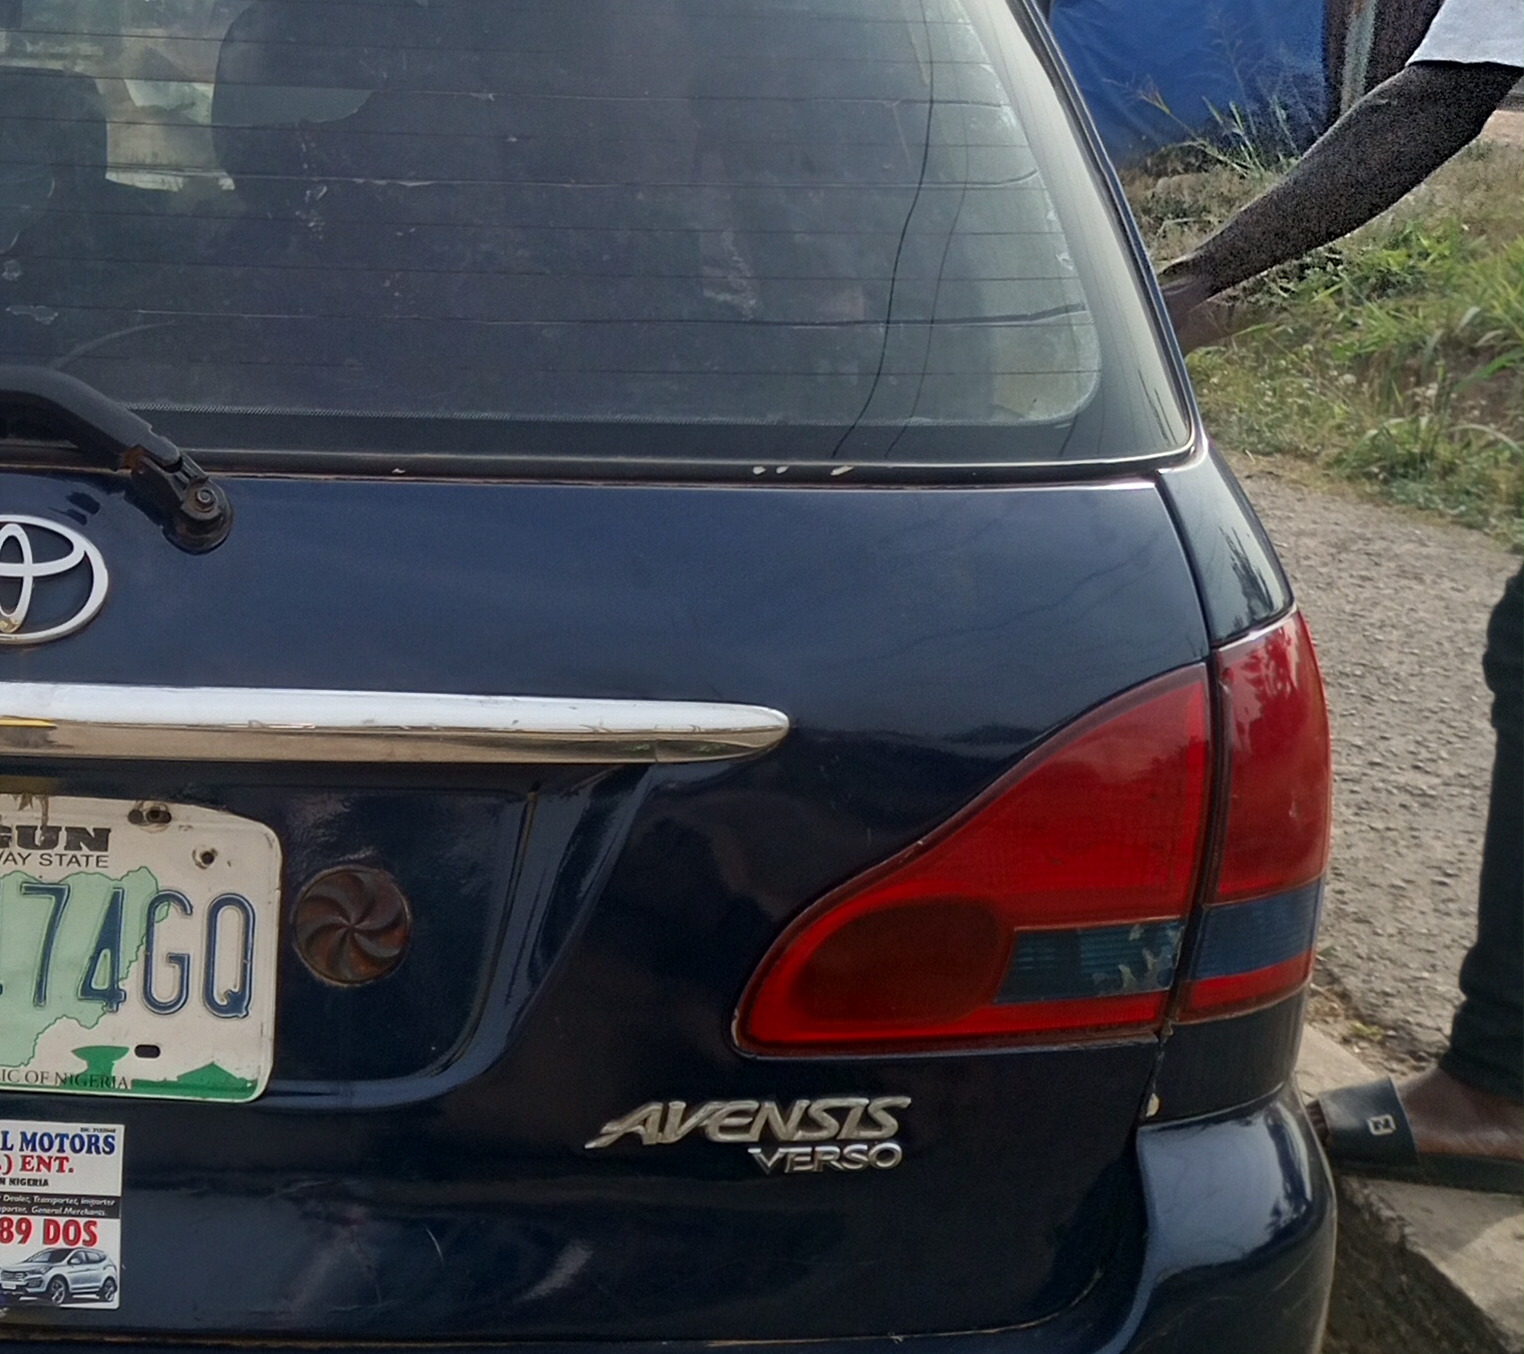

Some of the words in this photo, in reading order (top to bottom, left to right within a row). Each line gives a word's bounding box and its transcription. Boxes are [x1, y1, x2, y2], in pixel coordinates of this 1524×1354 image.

[38, 852, 110, 869] STATE
[25, 1069, 50, 1086] OF
[54, 1071, 129, 1090] NIGERIA
[584, 1096, 912, 1150] AVENSIS
[19, 1131, 116, 1155] MOTORS
[19, 1155, 74, 1173] ENT.
[747, 1142, 903, 1175] VERSO
[9, 1178, 49, 1187] NIGERIA
[42, 1218, 99, 1247] DOS
